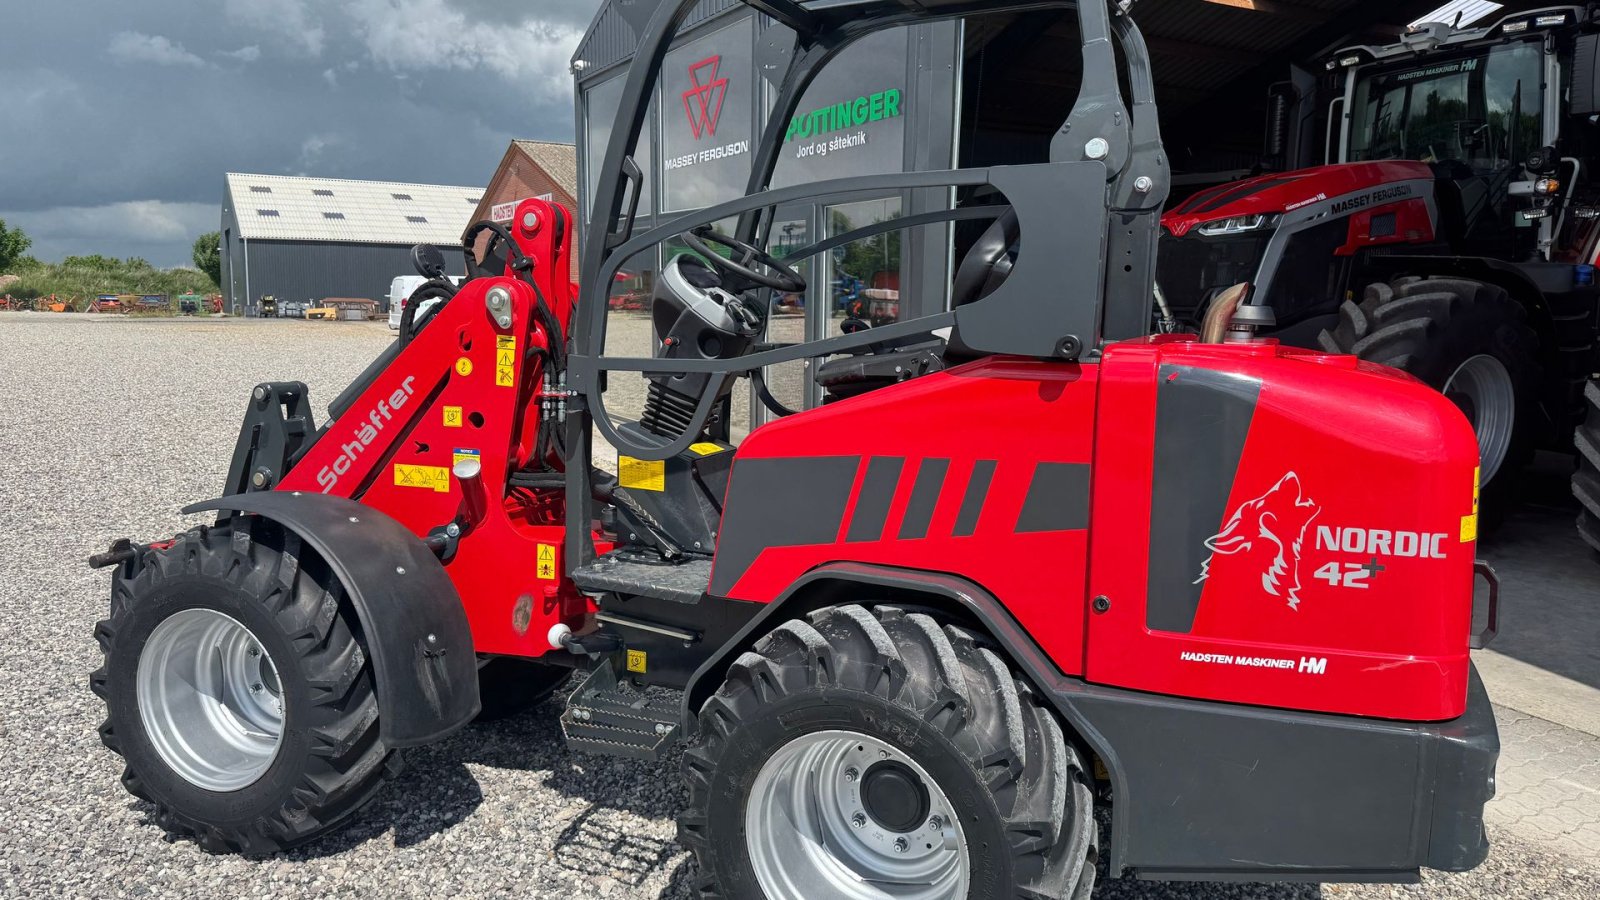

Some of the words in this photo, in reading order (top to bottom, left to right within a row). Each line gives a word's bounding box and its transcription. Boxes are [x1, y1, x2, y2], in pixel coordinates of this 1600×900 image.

[1397, 70, 1425, 81] HADSTEN
[1425, 64, 1459, 76] MASKINER
[1460, 59, 1477, 72] HM
[665, 153, 698, 171] MASSEY
[699, 140, 748, 163] FERGUSON
[796, 142, 814, 159] Jord
[816, 143, 827, 156] og
[828, 131, 866, 152] såteknik
[1331, 193, 1371, 215] MASSEY
[1372, 184, 1412, 202] FERGUSON
[316, 375, 415, 495] Schäffer
[1315, 525, 1449, 559] NORDIC
[1180, 651, 1233, 665] HADSTEN
[1235, 656, 1295, 669] MASKINER
[1298, 656, 1328, 675] HM
